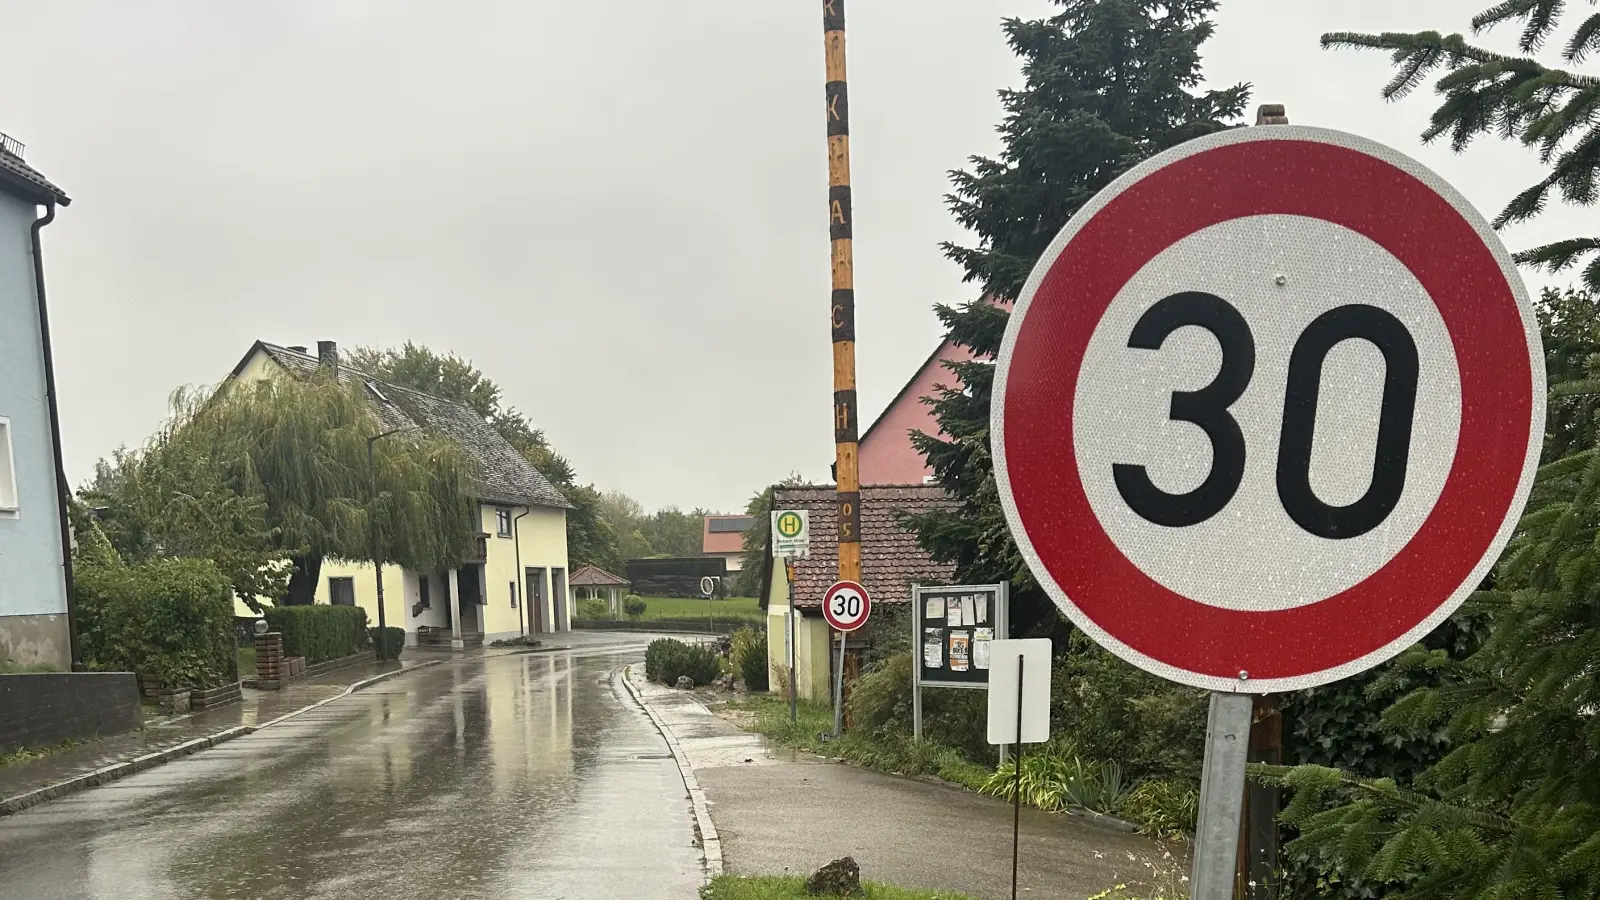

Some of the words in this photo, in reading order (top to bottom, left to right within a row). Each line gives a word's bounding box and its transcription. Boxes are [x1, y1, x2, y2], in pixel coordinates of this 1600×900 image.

[1112, 290, 1420, 540] 30
[784, 517, 795, 532] H
[833, 595, 860, 617] 30
